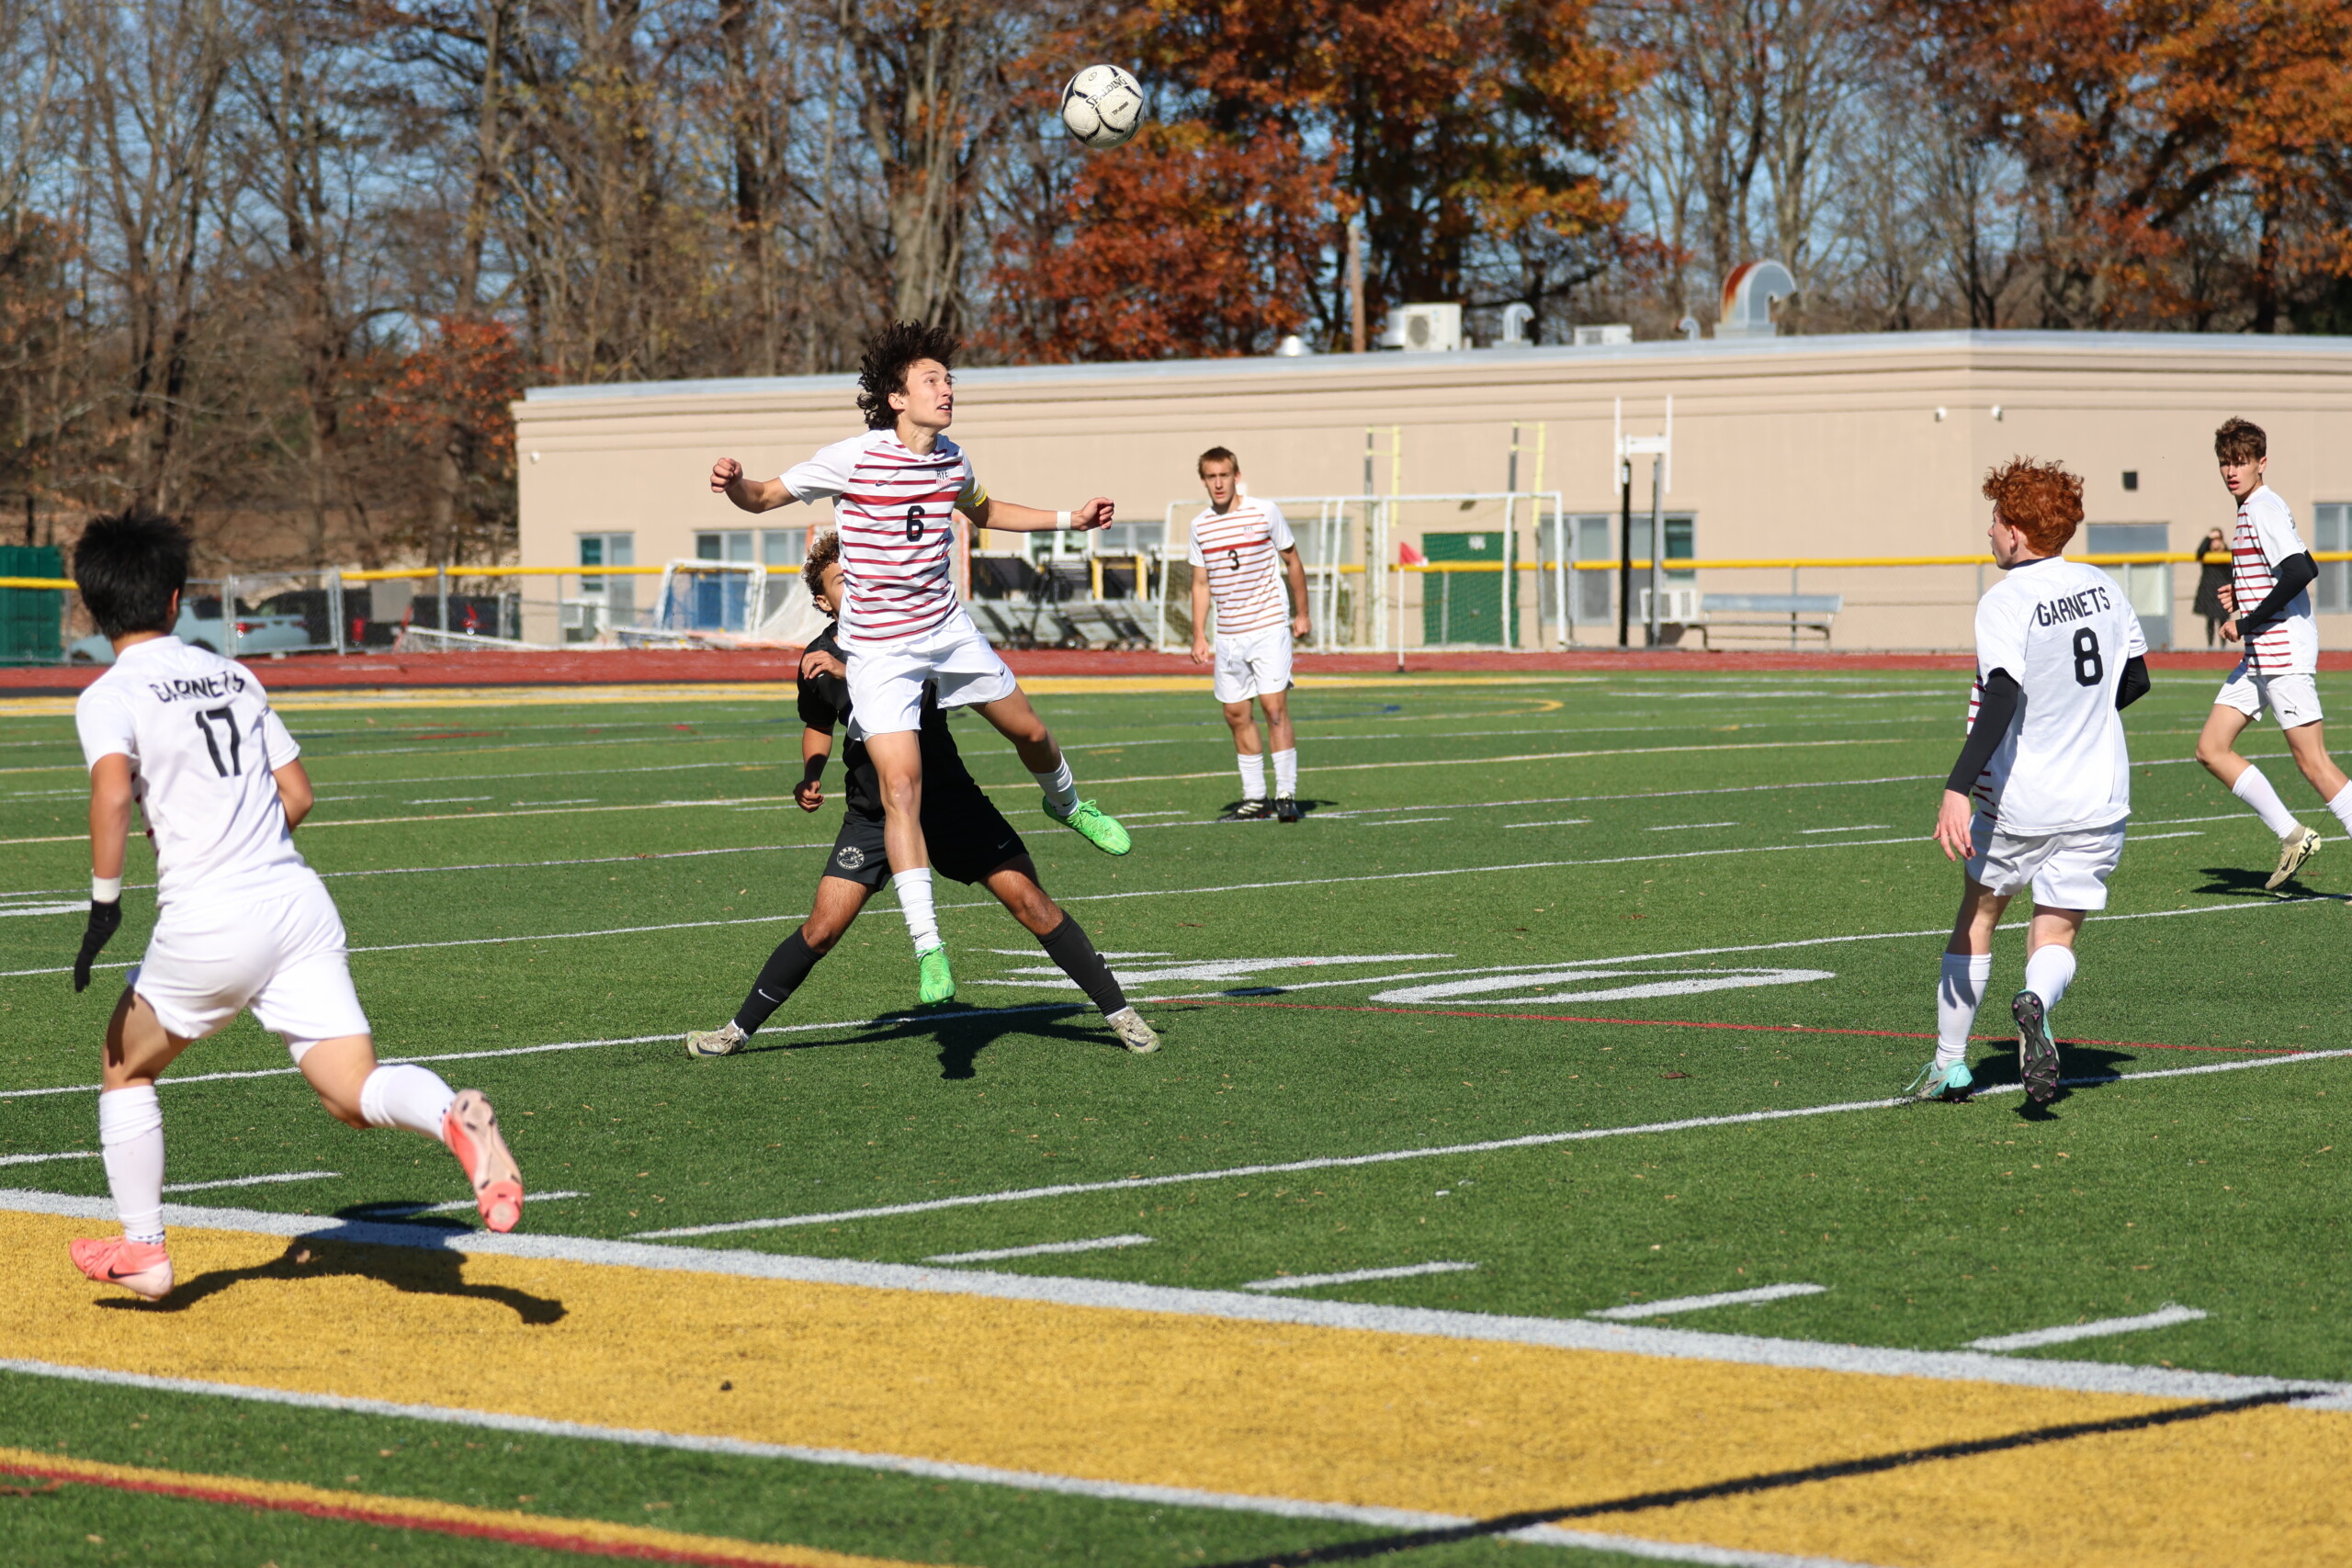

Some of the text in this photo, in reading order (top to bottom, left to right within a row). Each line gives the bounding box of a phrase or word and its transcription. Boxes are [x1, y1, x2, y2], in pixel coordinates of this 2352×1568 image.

[1086, 75, 1128, 109] SPALDING
[936, 468, 949, 479] RYE
[906, 505, 924, 542] 6
[1227, 549, 1240, 570] 3
[2036, 586, 2110, 627] GARNETS
[2073, 626, 2104, 687] 8
[148, 671, 245, 703] GARNETS
[196, 707, 241, 777] 17
